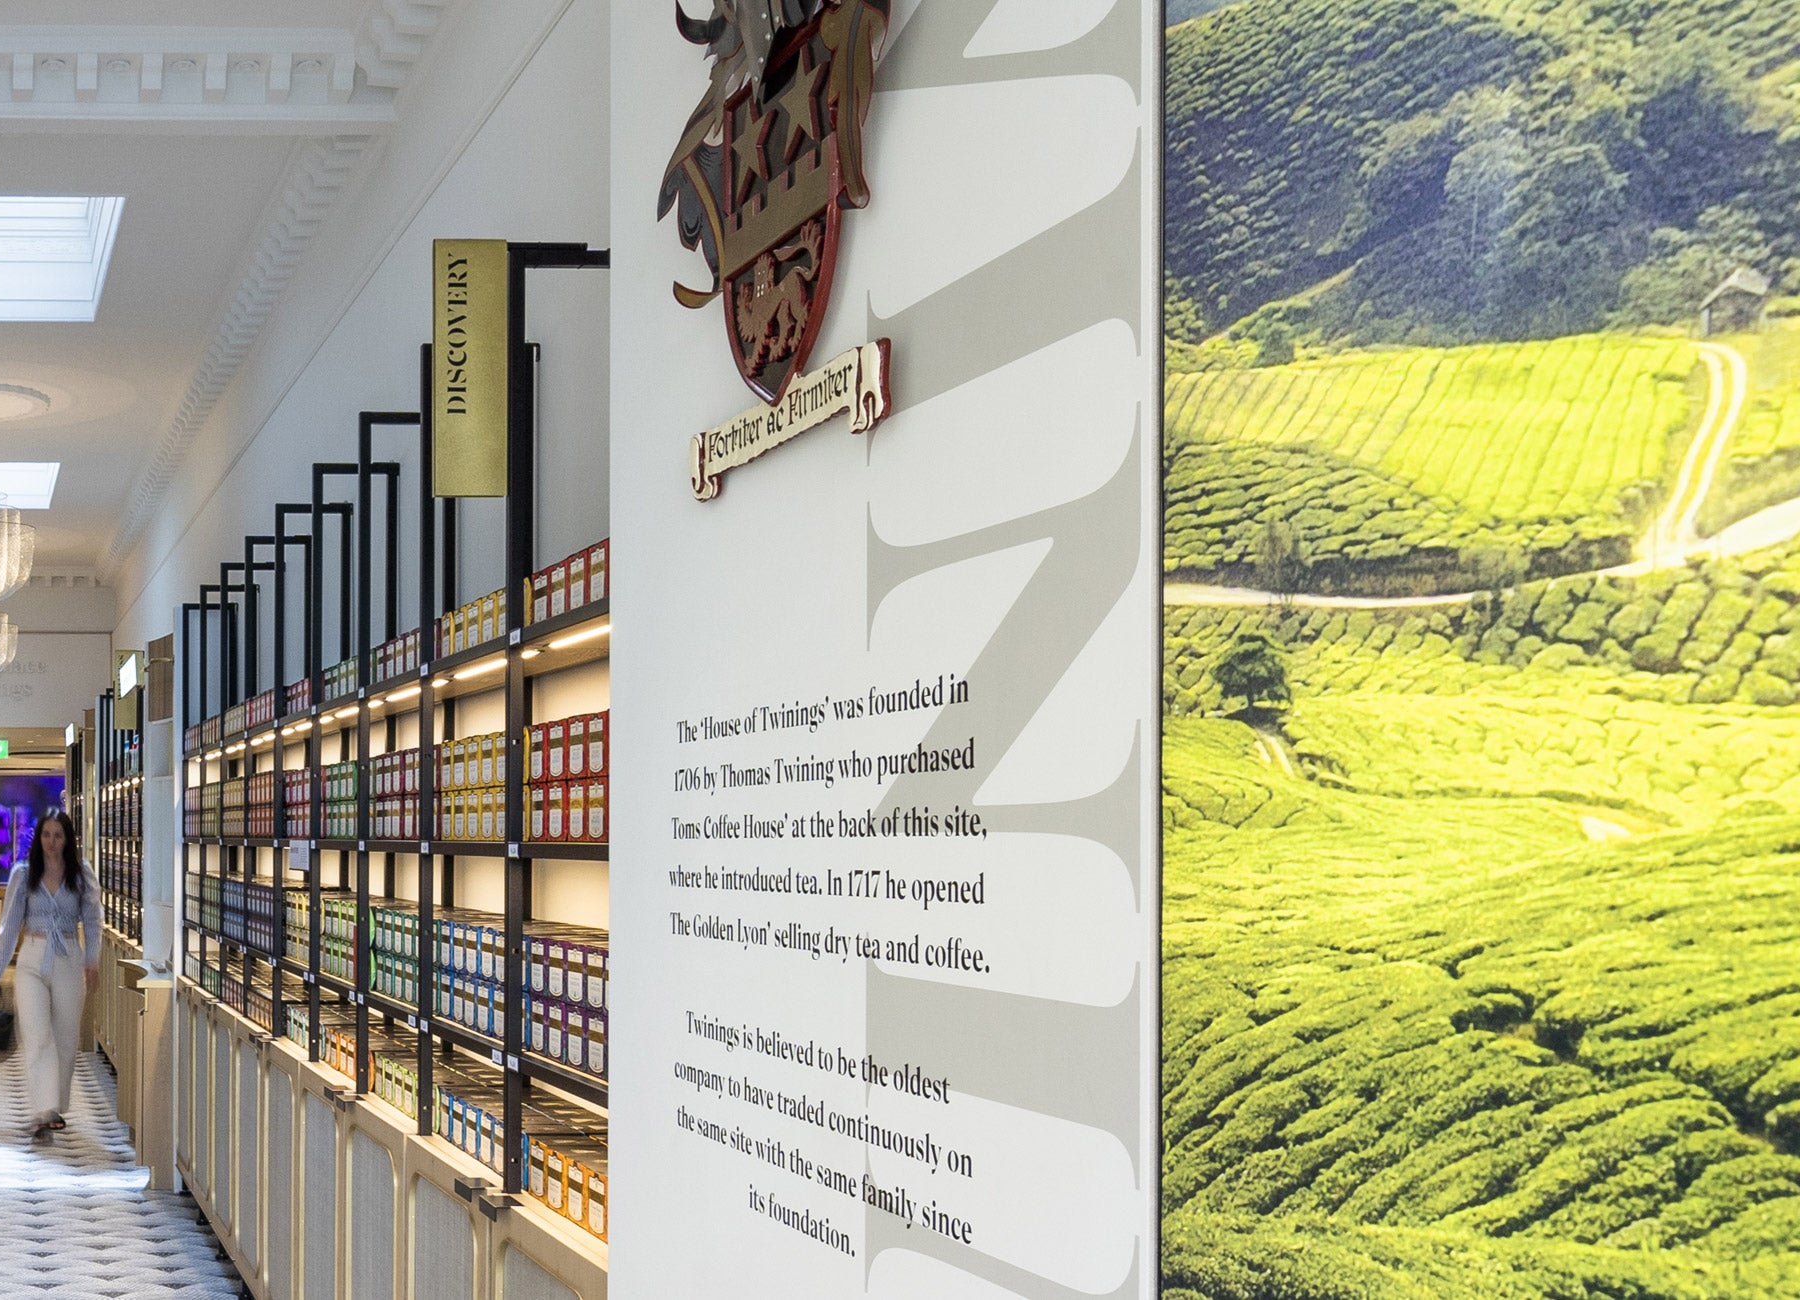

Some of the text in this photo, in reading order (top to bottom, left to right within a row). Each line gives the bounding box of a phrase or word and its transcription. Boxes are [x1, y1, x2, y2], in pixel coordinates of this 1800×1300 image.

[447, 253, 468, 414] DISCOVERY
[677, 721, 698, 743] The
[744, 708, 758, 734] of
[833, 700, 864, 721] was
[868, 675, 944, 716] founded
[949, 674, 969, 704] in
[674, 737, 975, 796] 1706 by Thomas Twining who purchased
[671, 818, 700, 839] Toms
[703, 815, 740, 839] Coffee
[792, 817, 806, 838] at
[810, 811, 834, 838] the
[838, 809, 876, 837] back
[881, 807, 900, 837] of
[904, 807, 939, 837] this
[944, 806, 988, 841] site,
[669, 865, 984, 910] where he introduced tea. In 1717 he opened
[670, 913, 690, 936] The
[693, 915, 733, 942] Golden
[774, 923, 820, 960] selling
[824, 927, 850, 963] dry
[856, 935, 880, 960] tea
[886, 935, 919, 965] and
[925, 938, 990, 973] coffee.
[686, 1011, 950, 1104] Twinings is believed to be the oldest
[674, 1063, 972, 1178] company to have traded continuously on
[677, 1106, 972, 1244] the same site with the same family since
[749, 1184, 855, 1257] its foundation.
